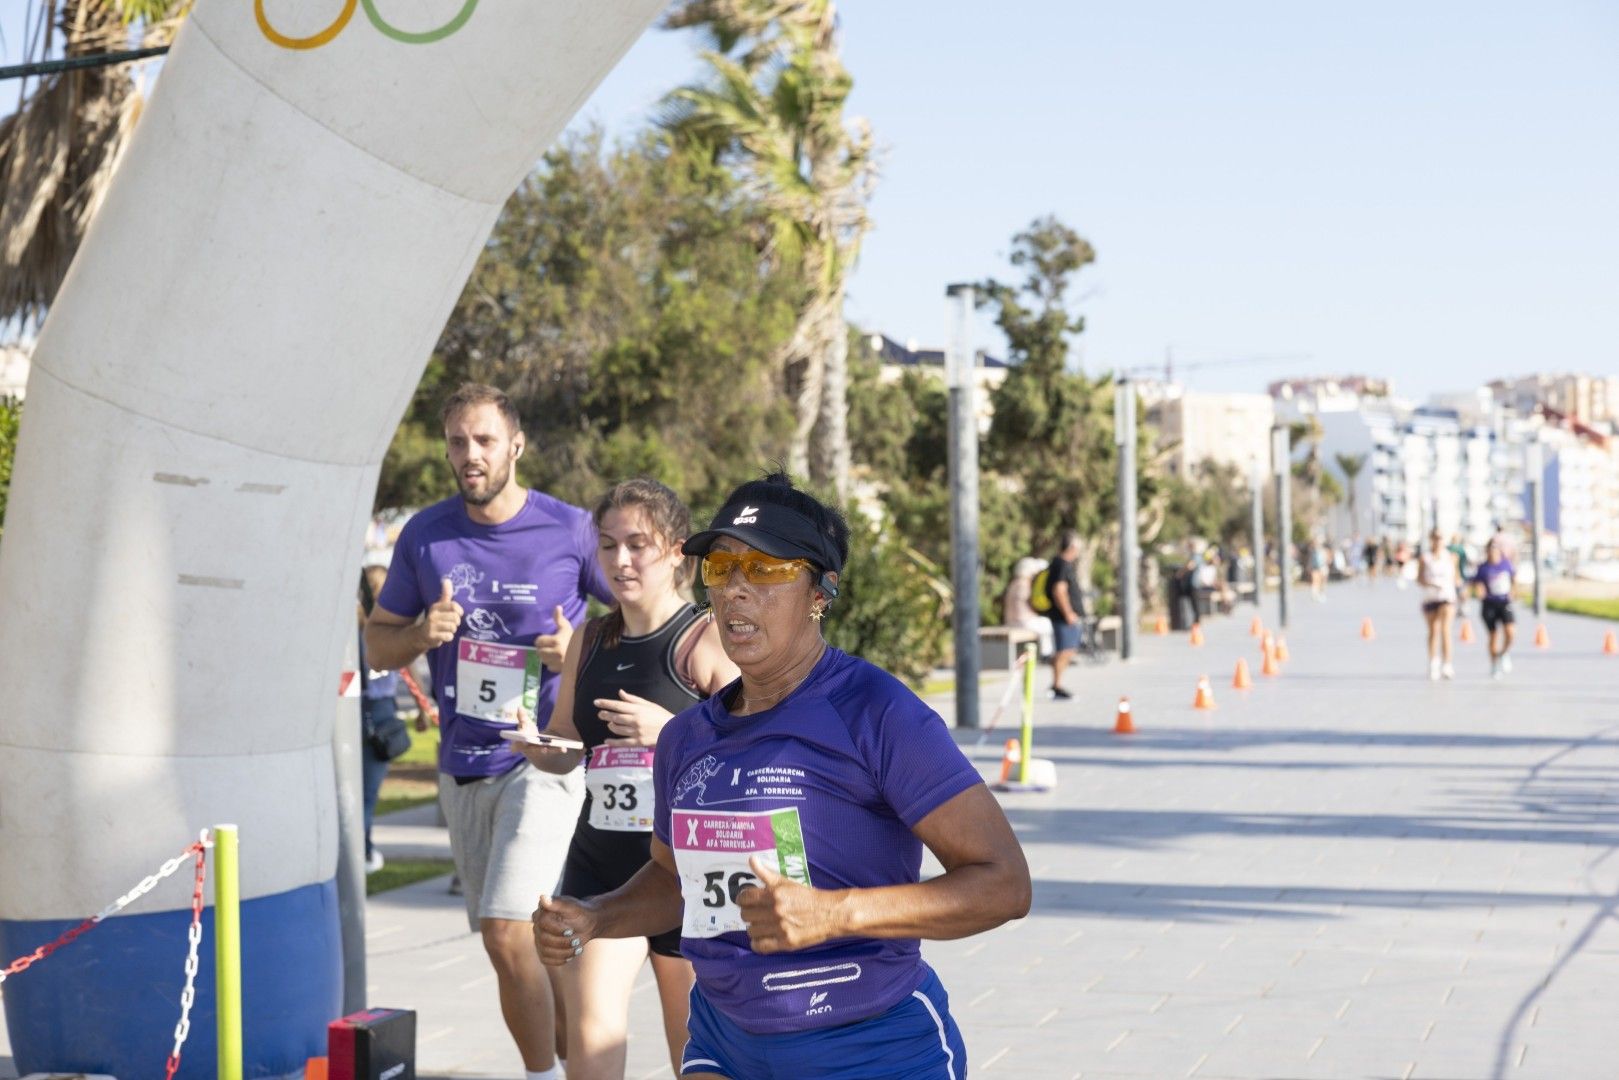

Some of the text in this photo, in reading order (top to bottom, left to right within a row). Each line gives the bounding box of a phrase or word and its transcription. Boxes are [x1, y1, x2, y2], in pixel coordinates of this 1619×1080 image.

[479, 680, 497, 703] 5
[730, 768, 742, 786] X
[747, 767, 805, 777] CARRERA/MARCHA
[757, 775, 791, 783] SOLIDARIA
[745, 787, 802, 796] AFA TORREVIEJA
[603, 783, 638, 811] 33
[703, 820, 755, 831] CARRERA/MARCHA
[686, 818, 699, 846] X
[715, 830, 743, 839] SOLIDARIA
[706, 839, 756, 849] AFA TORREVIEJA
